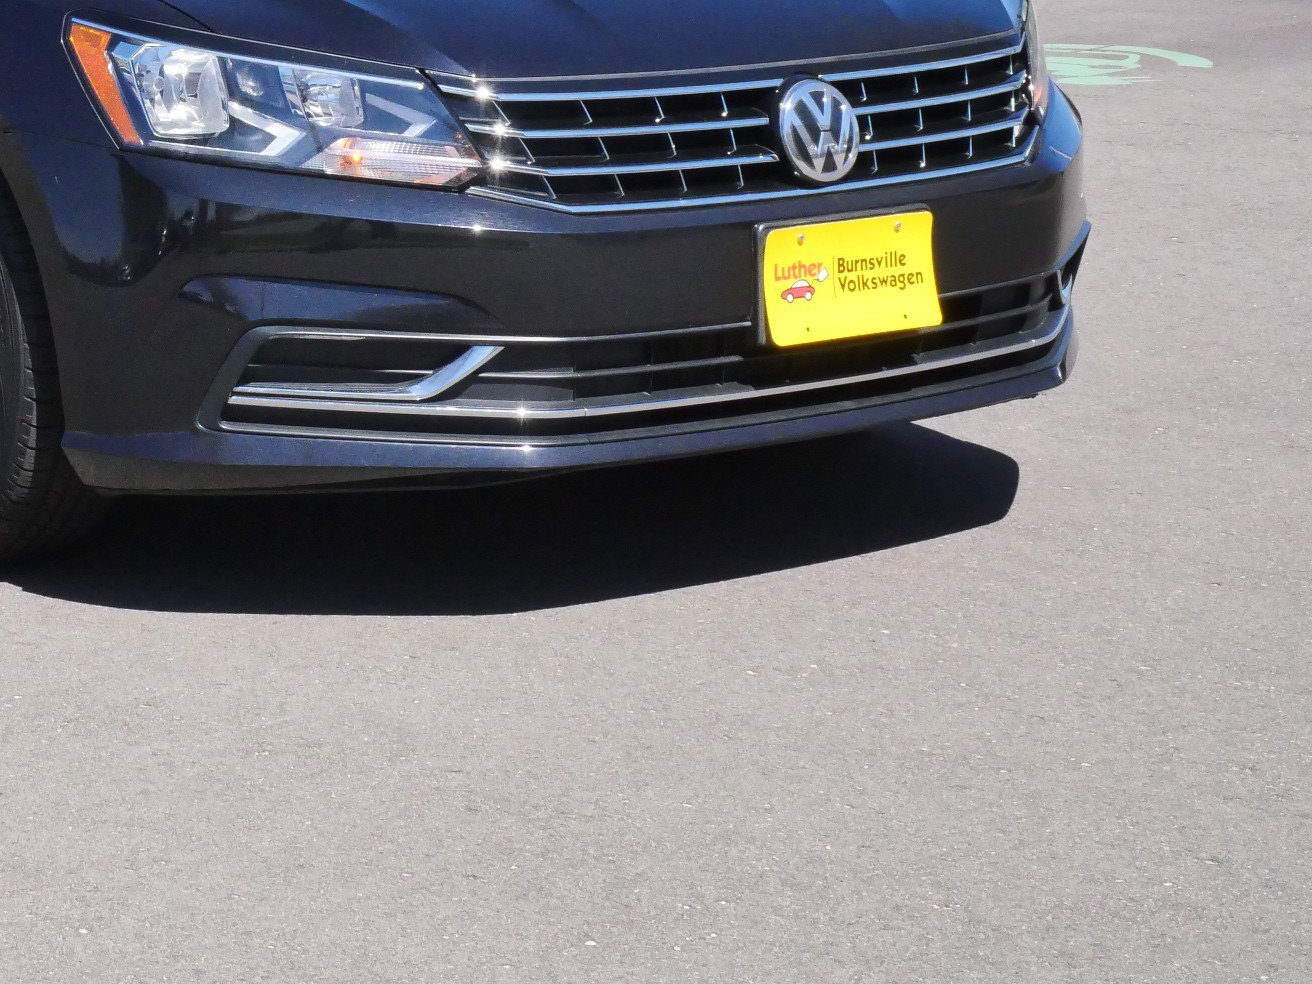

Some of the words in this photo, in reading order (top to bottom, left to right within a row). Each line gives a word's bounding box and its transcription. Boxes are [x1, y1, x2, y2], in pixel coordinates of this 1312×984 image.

[774, 260, 824, 282] Luther
[837, 250, 906, 274] Burnsville
[838, 271, 924, 293] Volkswagen
